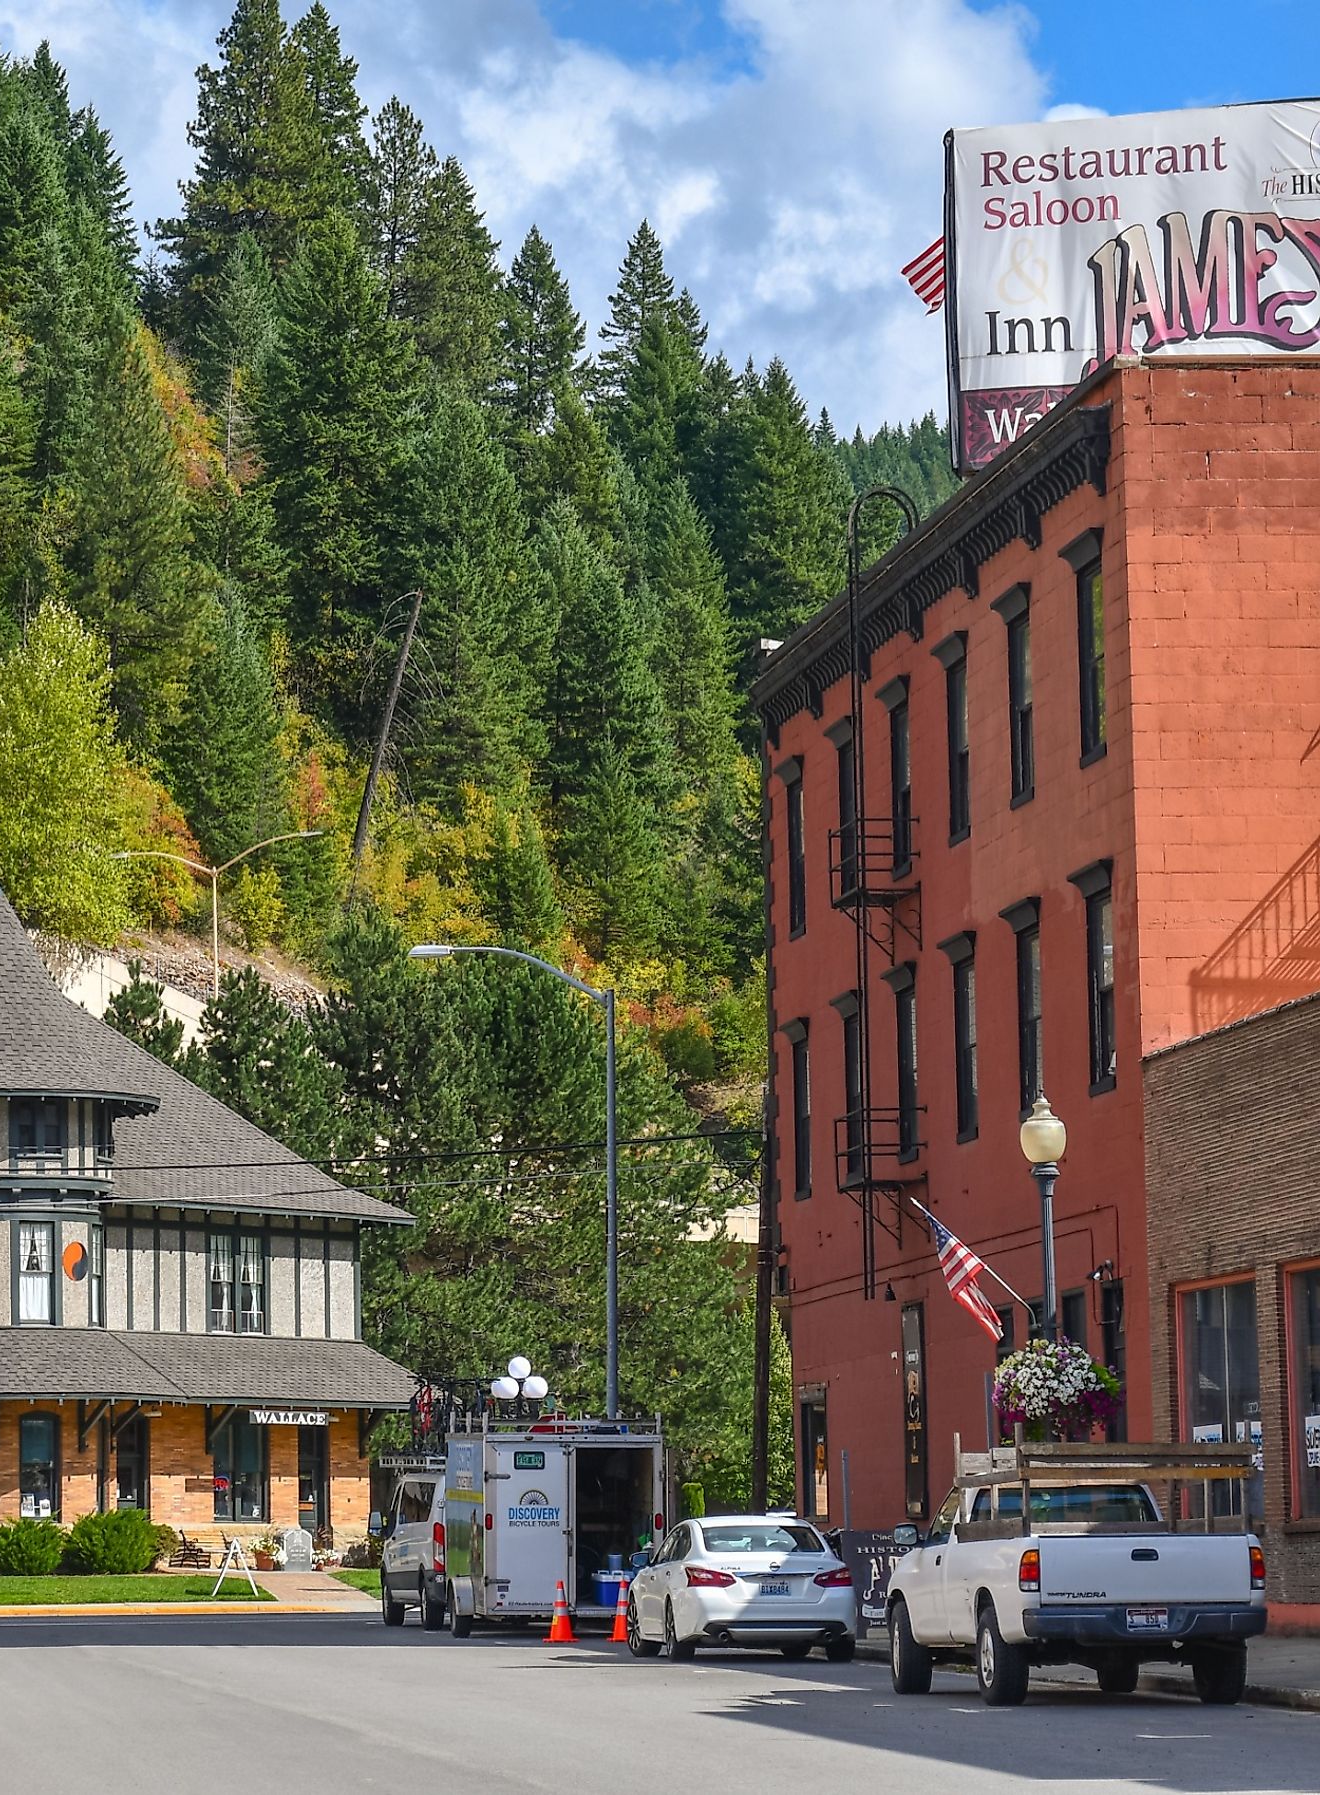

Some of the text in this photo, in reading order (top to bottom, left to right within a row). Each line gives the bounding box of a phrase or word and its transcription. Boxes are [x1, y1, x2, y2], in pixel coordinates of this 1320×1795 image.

[980, 136, 1227, 187] Restaurant
[1262, 175, 1288, 197] The
[983, 190, 1120, 230] Saloon
[997, 237, 1049, 305] &
[984, 310, 1074, 356] Inn
[254, 1411, 326, 1425] WALLACE
[508, 1507, 560, 1520] DISCOVERY
[1066, 1591, 1107, 1599] TUNDRA
